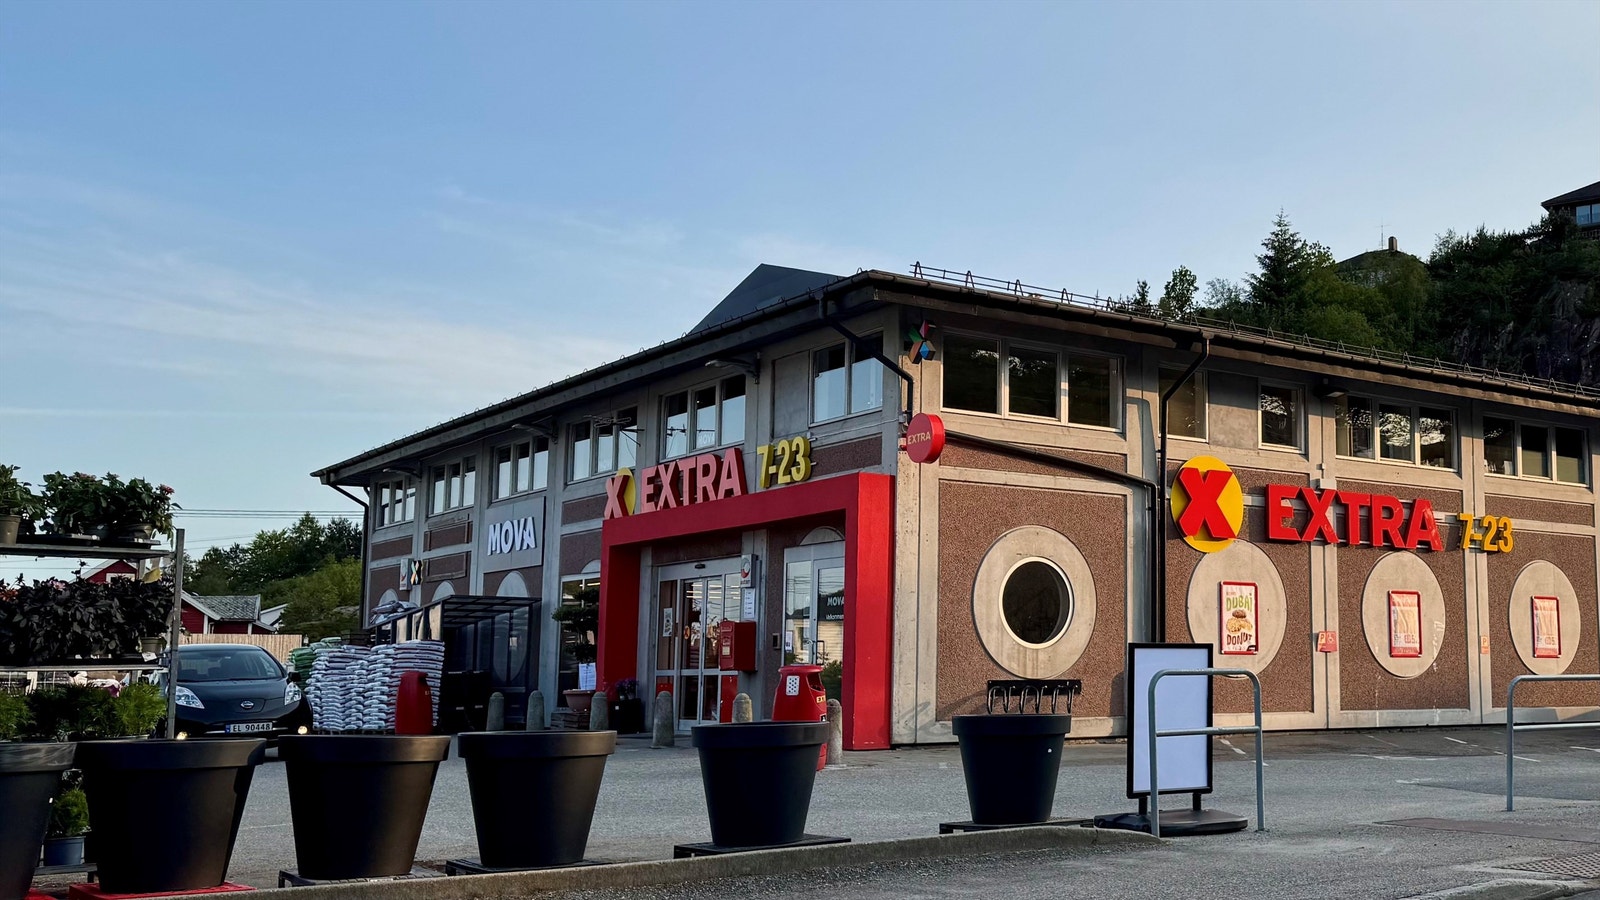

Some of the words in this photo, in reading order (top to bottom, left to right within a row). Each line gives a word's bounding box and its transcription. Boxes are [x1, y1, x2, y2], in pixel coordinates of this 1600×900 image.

[907, 431, 931, 445] EXTRA
[641, 447, 746, 513] EXTRA
[757, 436, 810, 488] 7-23
[1265, 483, 1443, 551] EXTRA
[1457, 512, 1514, 553] 7-23
[487, 516, 537, 556] MOVA
[1226, 632, 1253, 646] DONUT
[232, 724, 241, 732] EL
[245, 723, 271, 732] 90448
